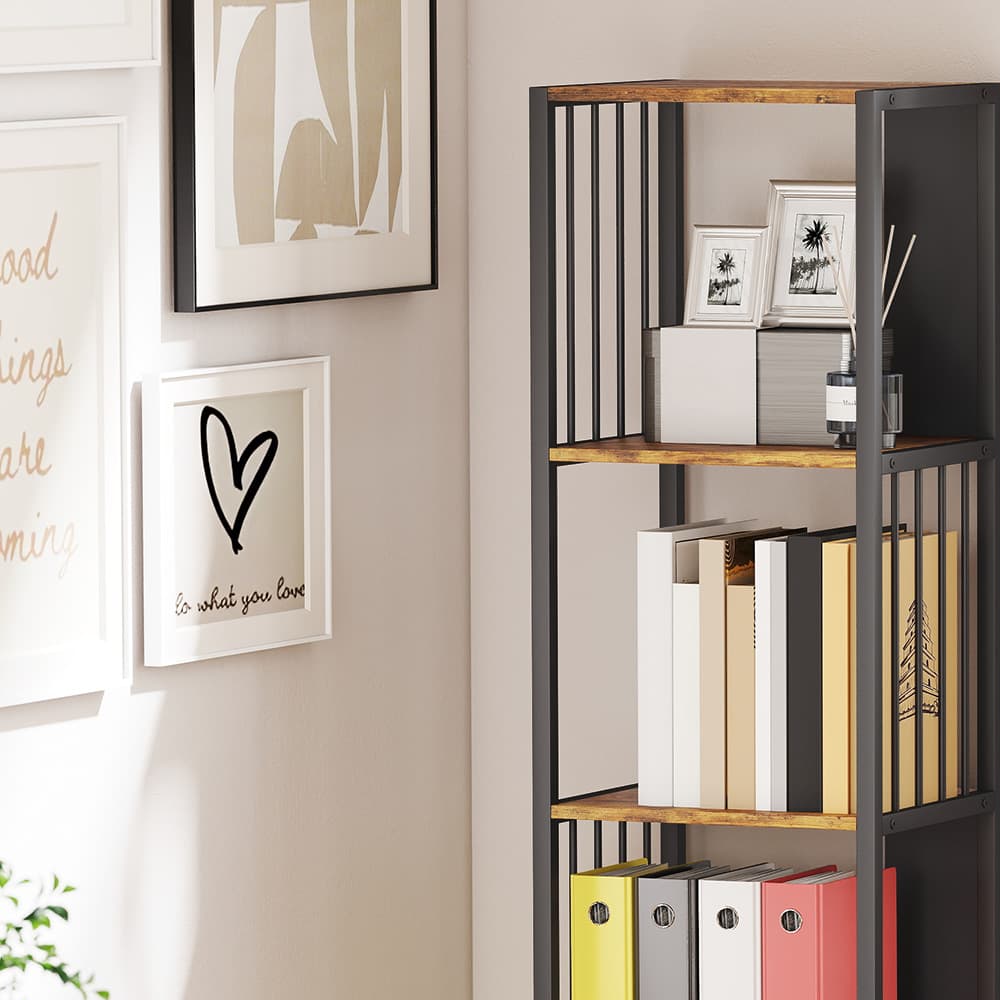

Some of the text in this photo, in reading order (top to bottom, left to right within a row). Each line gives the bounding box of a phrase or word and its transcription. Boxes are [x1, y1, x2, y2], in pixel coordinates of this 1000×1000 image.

[0, 211, 59, 285] ood
[0, 319, 73, 407] ings
[0, 431, 52, 481] are
[0, 511, 78, 580] ming
[197, 584, 237, 612] what
[241, 590, 272, 615] you
[276, 576, 305, 600] love
